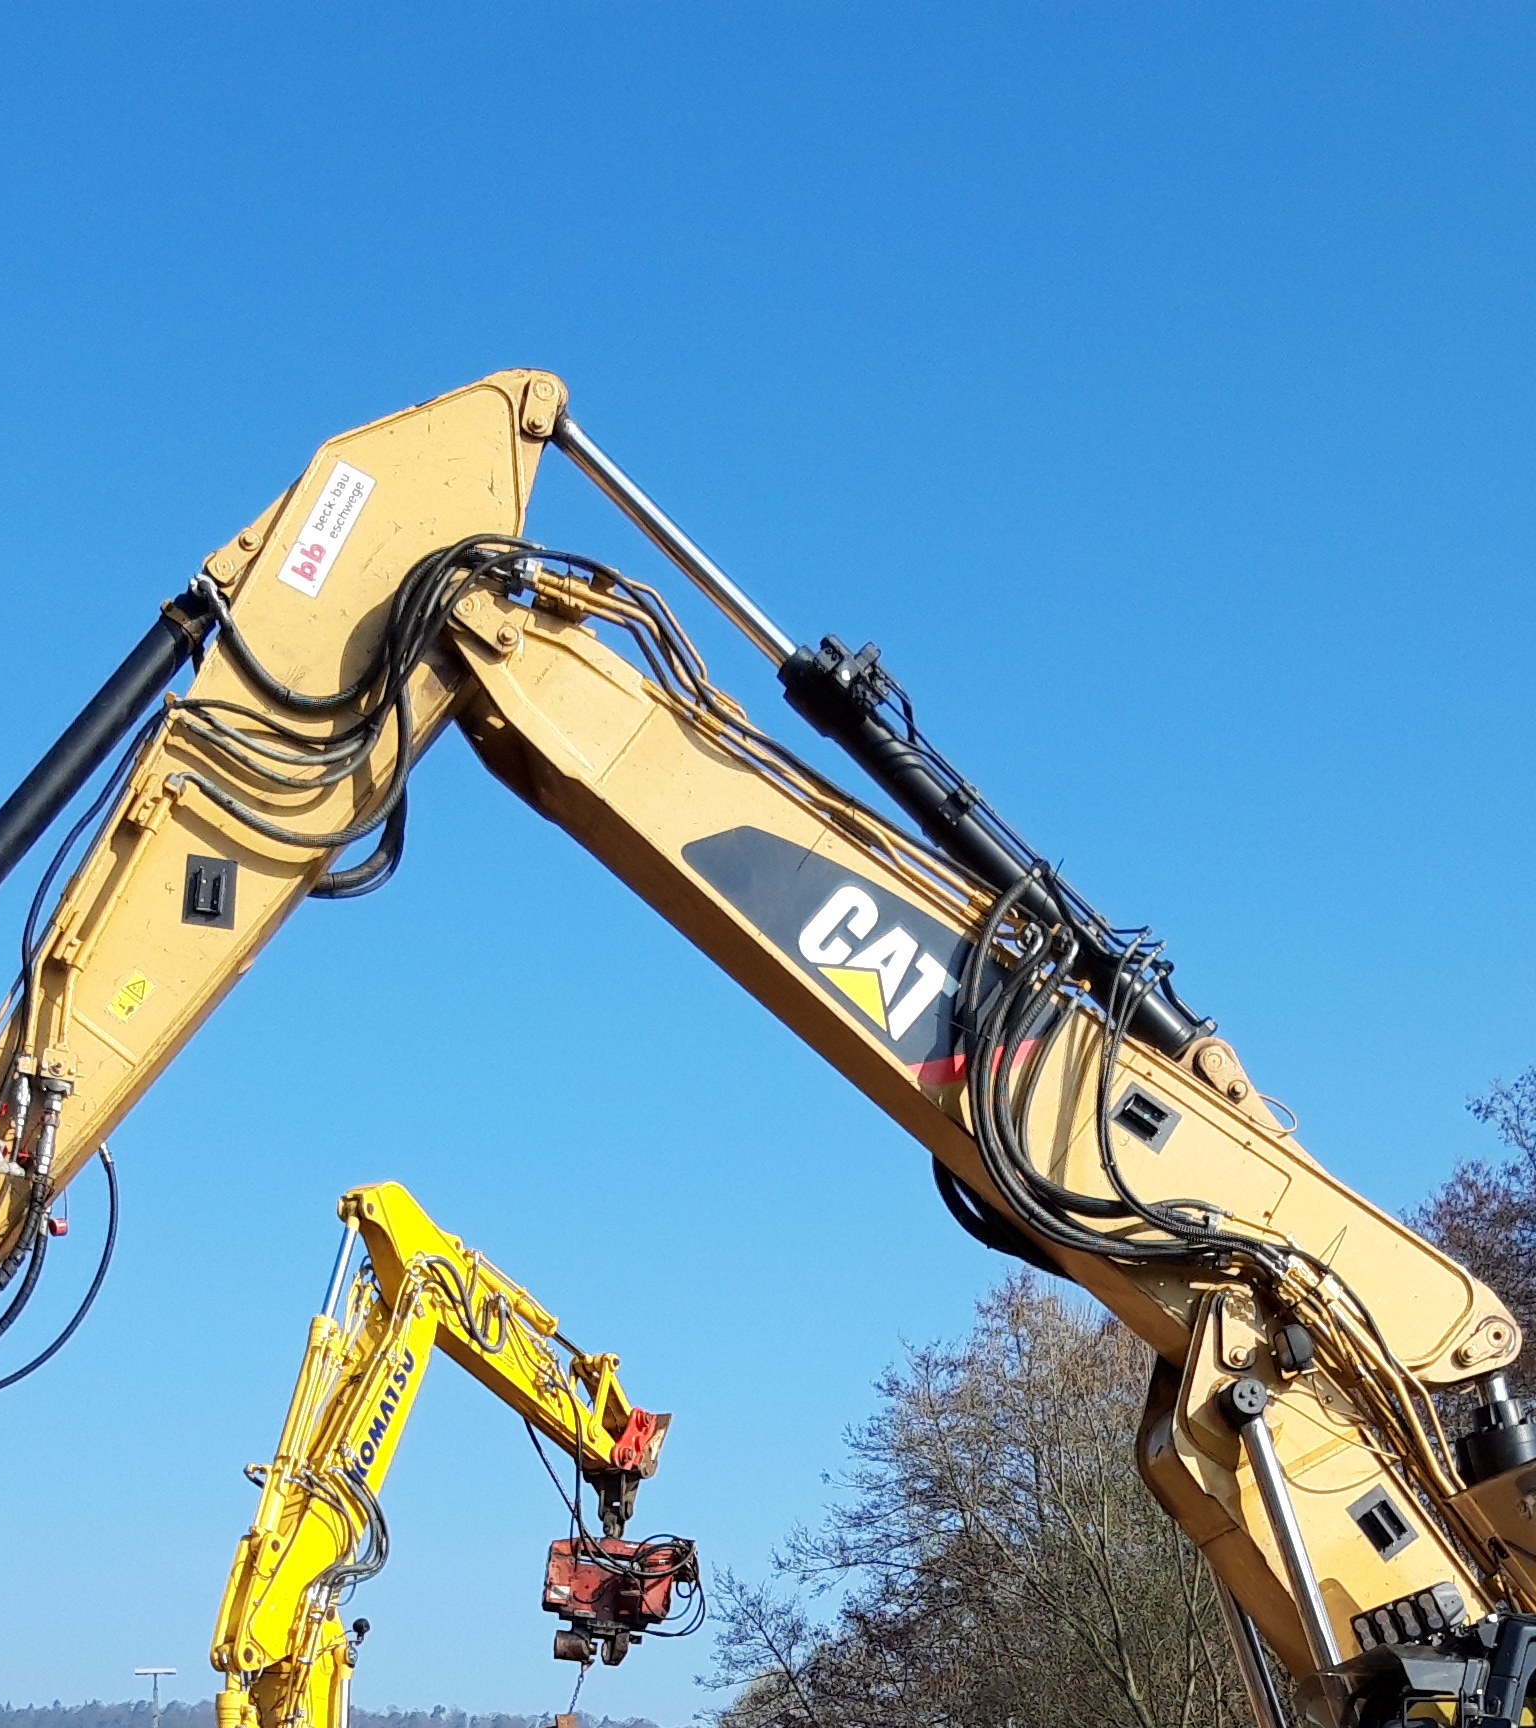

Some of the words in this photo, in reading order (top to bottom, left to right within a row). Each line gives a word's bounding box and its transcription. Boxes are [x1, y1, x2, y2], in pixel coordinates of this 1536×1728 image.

[329, 481, 365, 540] eschwege
[291, 543, 327, 582] bb
[798, 885, 961, 1042] CAT
